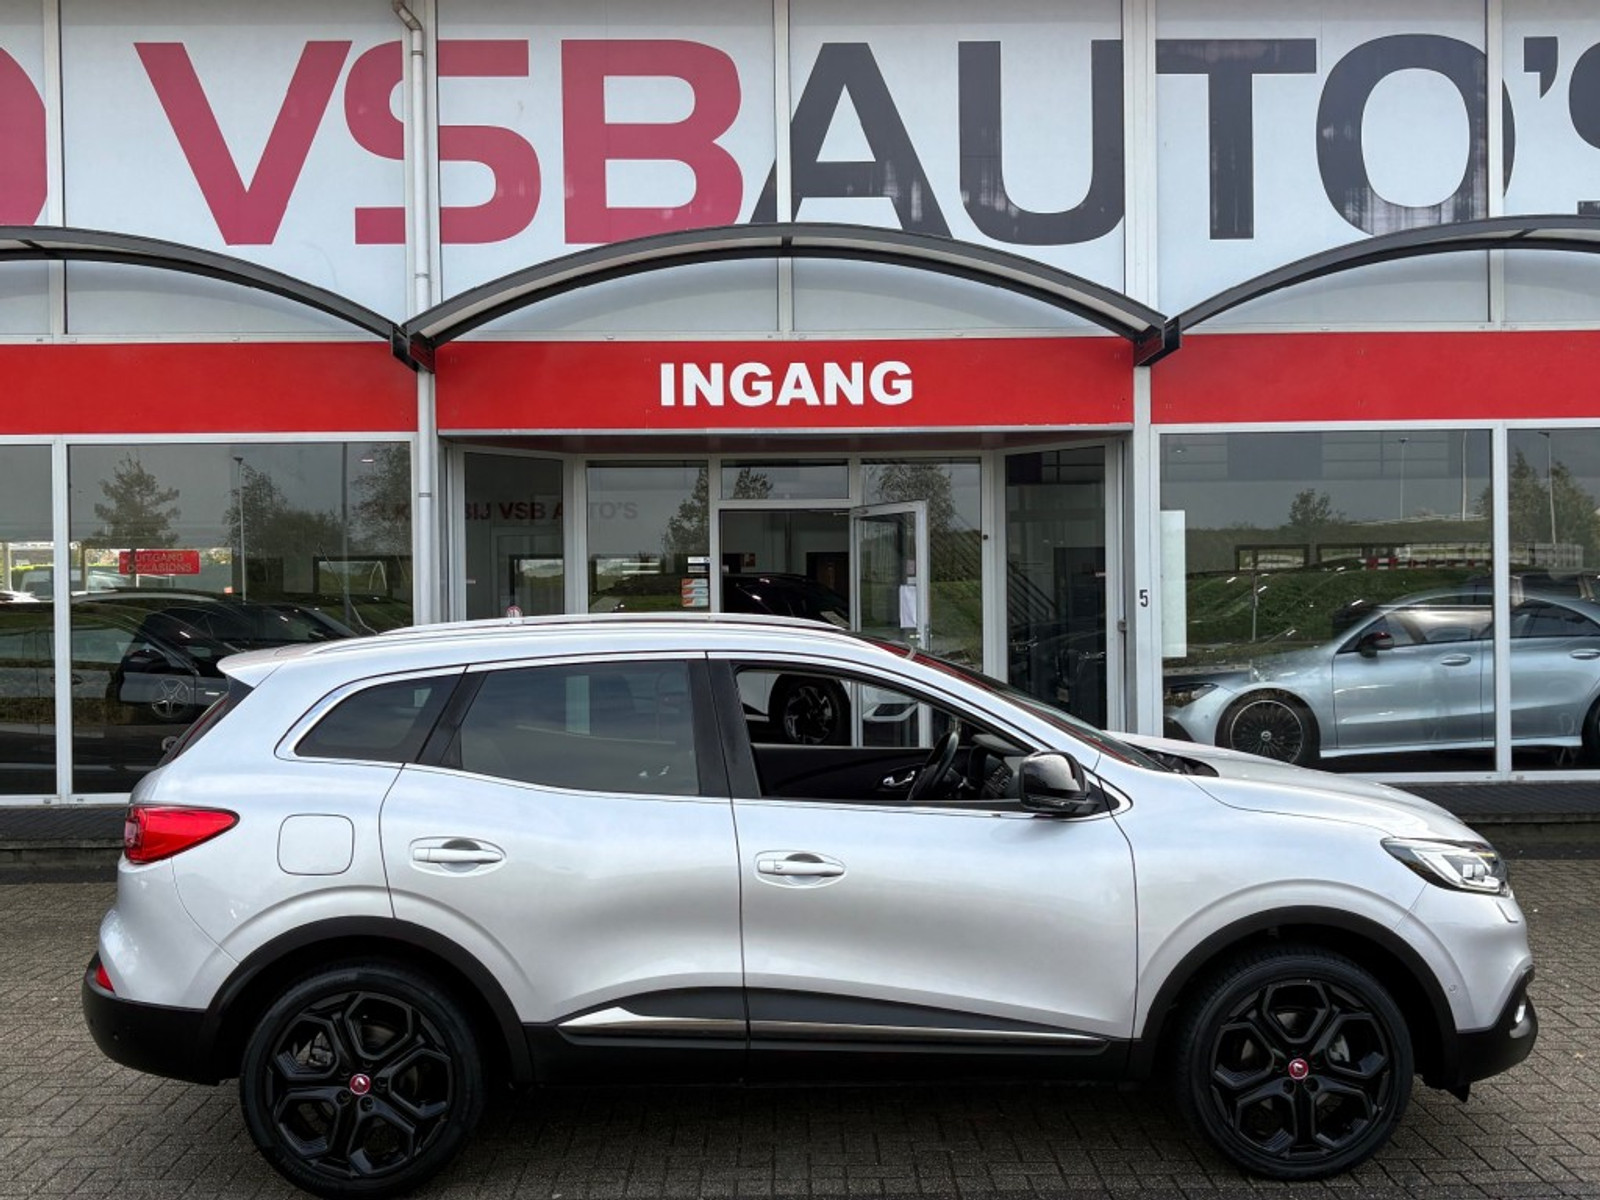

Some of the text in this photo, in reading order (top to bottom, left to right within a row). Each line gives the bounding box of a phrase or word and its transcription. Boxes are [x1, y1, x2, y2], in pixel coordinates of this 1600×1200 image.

[660, 360, 913, 407] INGANG
[498, 502, 545, 520] VSB
[552, 502, 638, 520] ATO'S
[1139, 589, 1148, 608] 5
